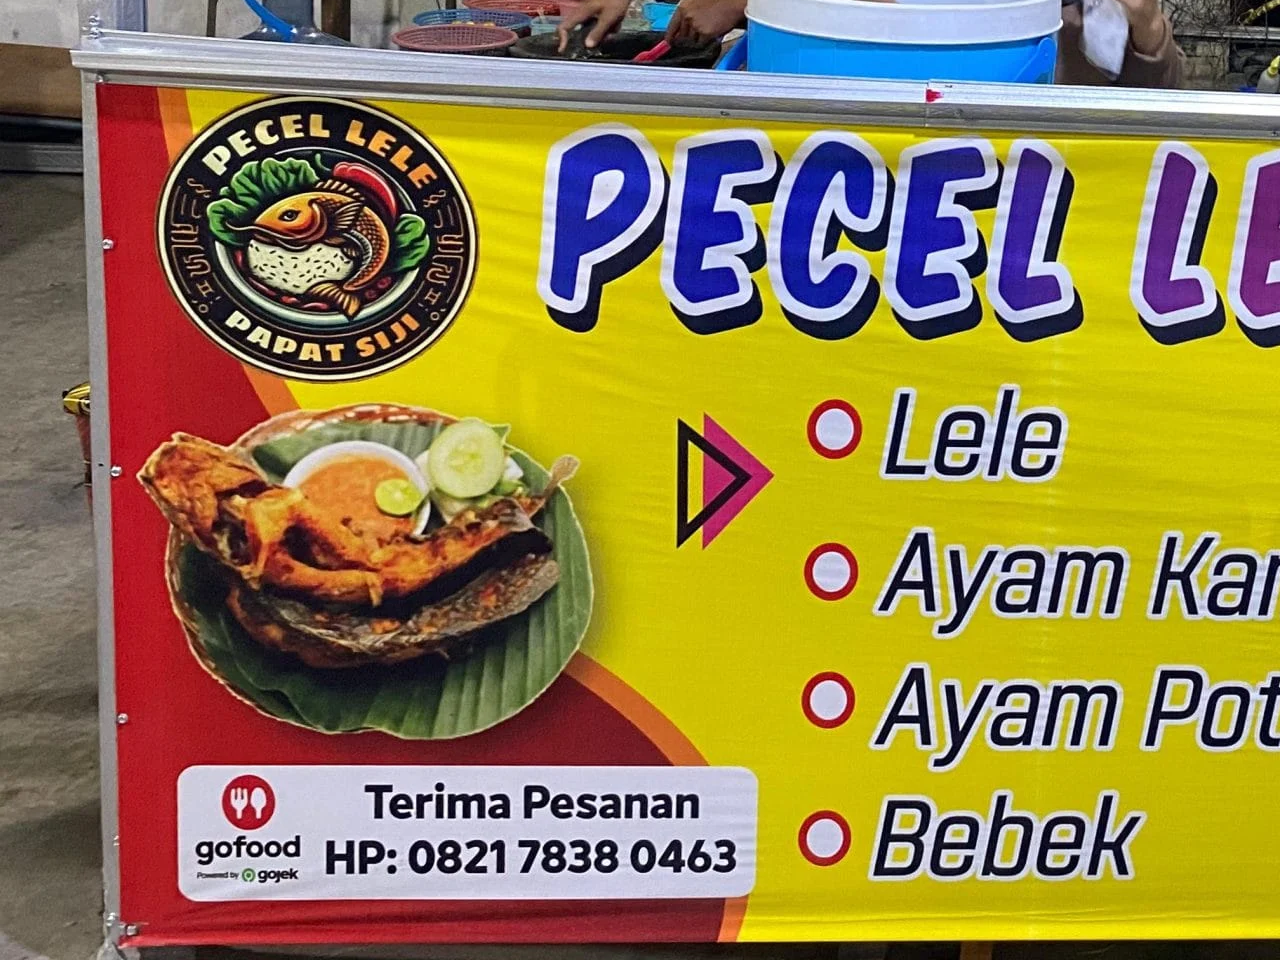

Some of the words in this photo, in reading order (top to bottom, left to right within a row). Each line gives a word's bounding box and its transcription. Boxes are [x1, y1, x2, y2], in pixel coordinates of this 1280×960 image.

[201, 113, 331, 178] PECEL
[343, 118, 440, 190] LELE
[537, 123, 1084, 342] PECEL
[223, 309, 345, 363] PAPAT
[357, 312, 420, 359] SIJI
[881, 387, 1064, 479] Lele
[874, 531, 1125, 634] Ayam
[873, 667, 1120, 768] Ayam
[365, 784, 510, 819] Terima
[524, 786, 699, 819] Pesanan
[872, 793, 1140, 878] Bebek
[195, 835, 301, 866] gofood
[258, 868, 299, 883] gojek
[326, 839, 397, 875] HP:
[408, 840, 506, 874] 0821
[518, 839, 618, 874] 7838
[630, 839, 736, 874] 0463
